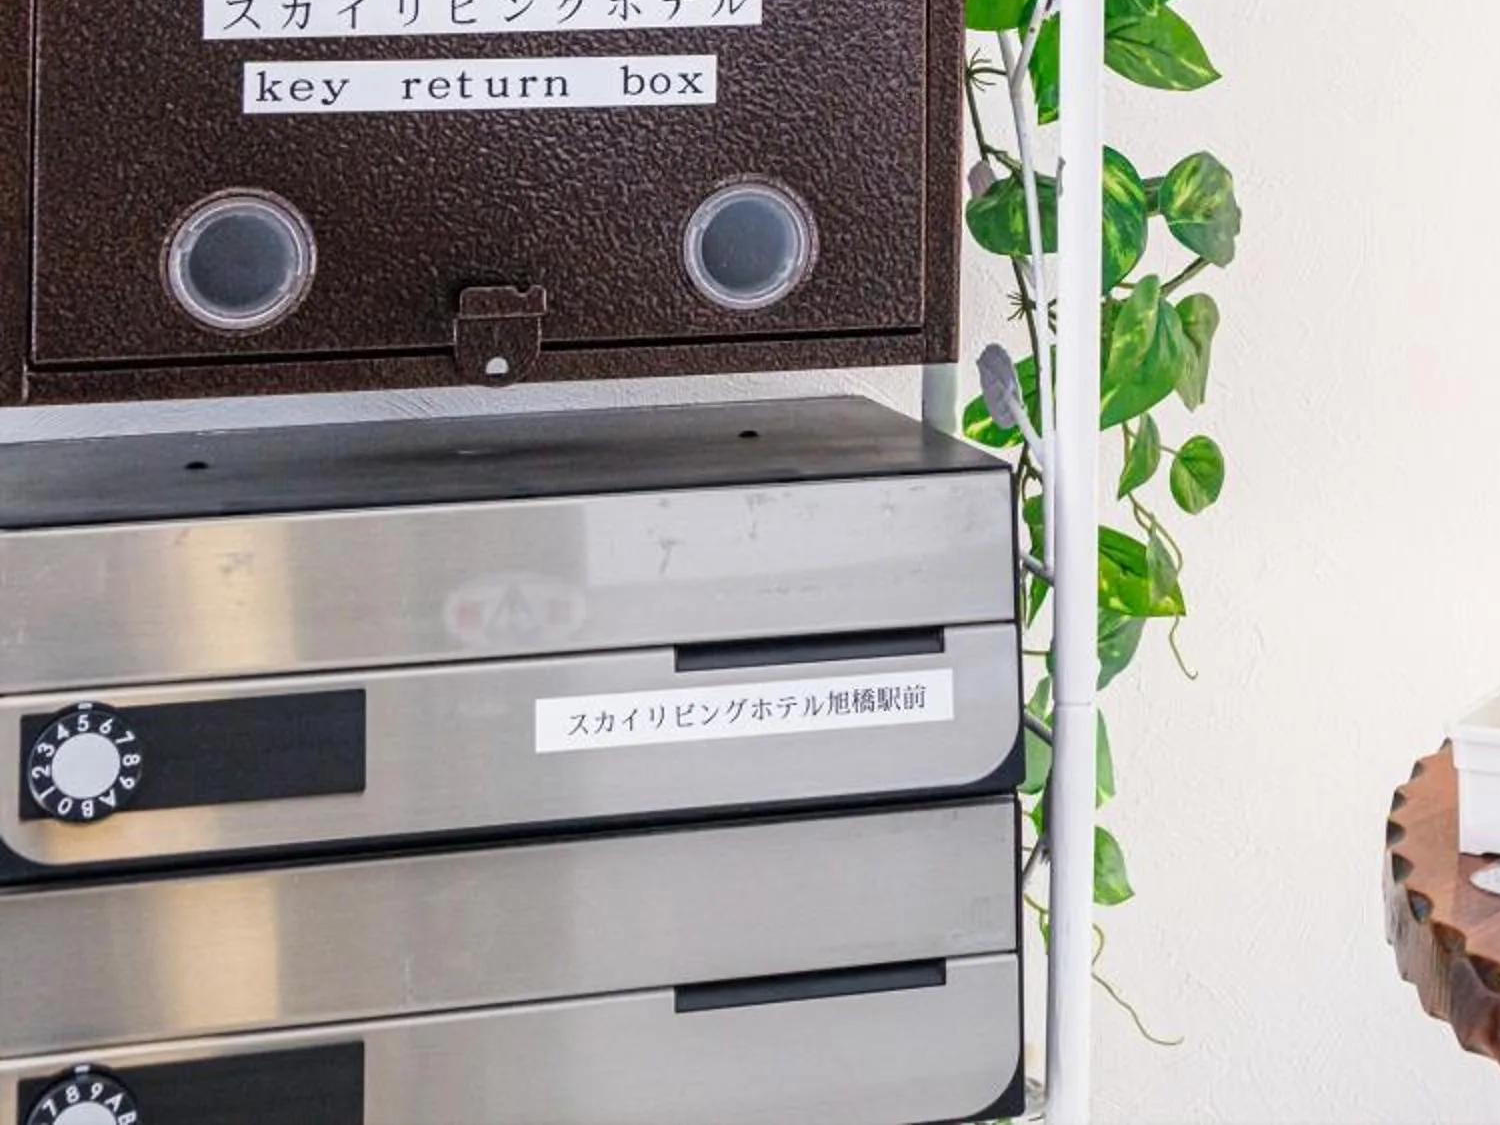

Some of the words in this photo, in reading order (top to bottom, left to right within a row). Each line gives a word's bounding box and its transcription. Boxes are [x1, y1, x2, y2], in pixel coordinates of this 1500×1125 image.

[255, 70, 351, 106] key
[401, 71, 570, 100] return
[620, 66, 704, 95] box
[567, 684, 926, 736] スカイリビングホテル旭橋駅前
